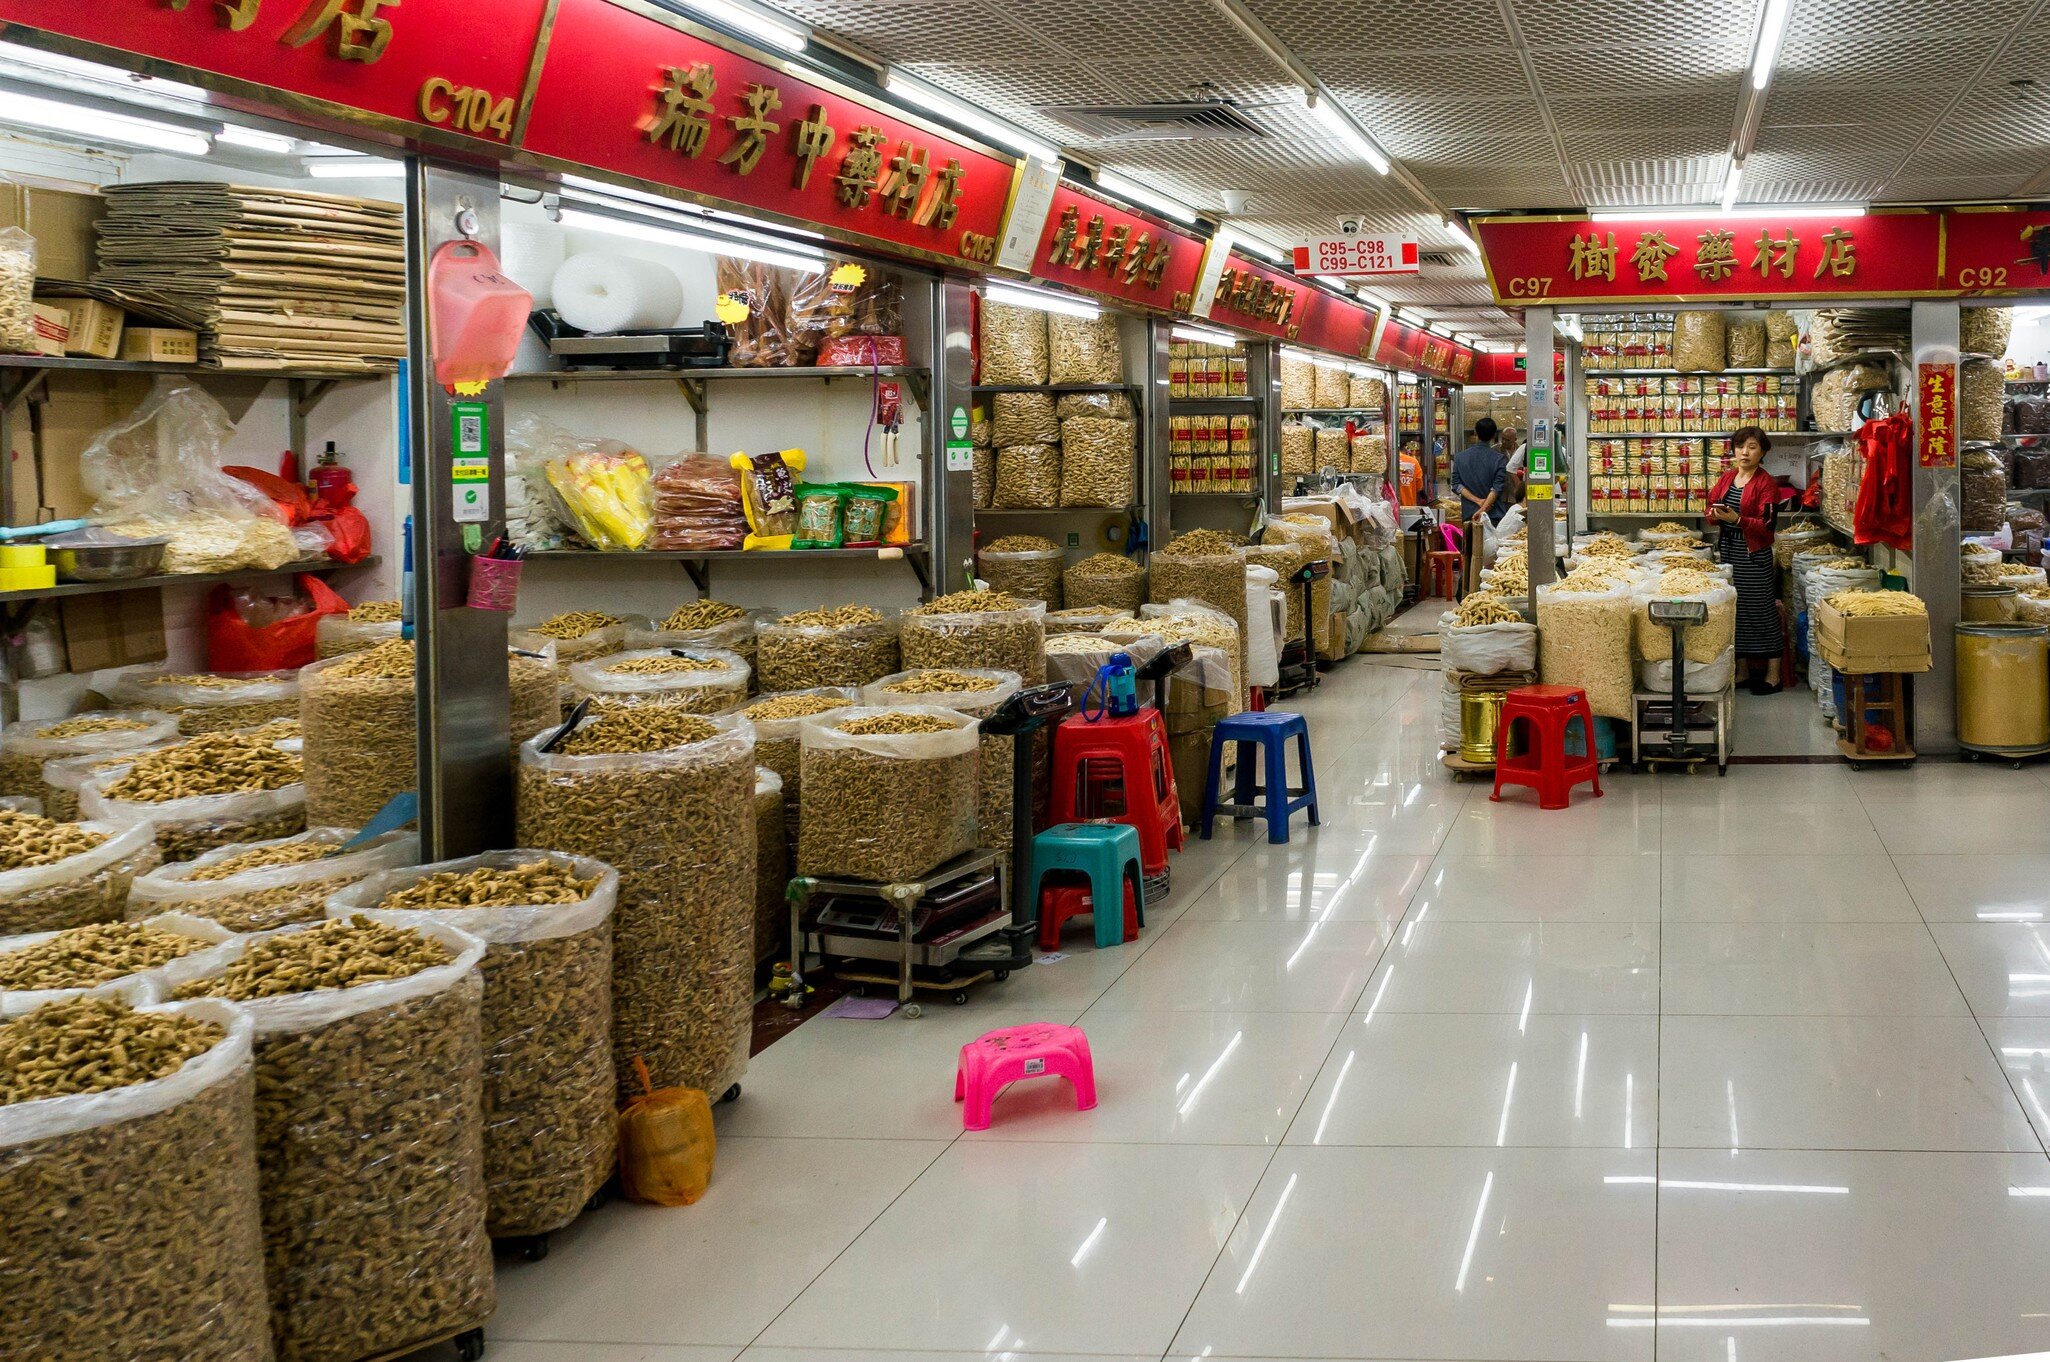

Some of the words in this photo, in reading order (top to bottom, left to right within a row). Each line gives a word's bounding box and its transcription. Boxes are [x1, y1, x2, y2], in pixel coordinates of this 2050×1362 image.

[418, 76, 514, 139] C104
[637, 62, 967, 230] 瑞芳中藥材店
[959, 230, 996, 262] C105
[1319, 240, 1385, 256] C95-C98
[1567, 226, 1857, 282] 樹發藥材店
[1320, 255, 1394, 271] C99-C121
[1958, 267, 2008, 287] C92
[1508, 276, 1553, 297] C97
[1926, 374, 1949, 456] 生意興隆
